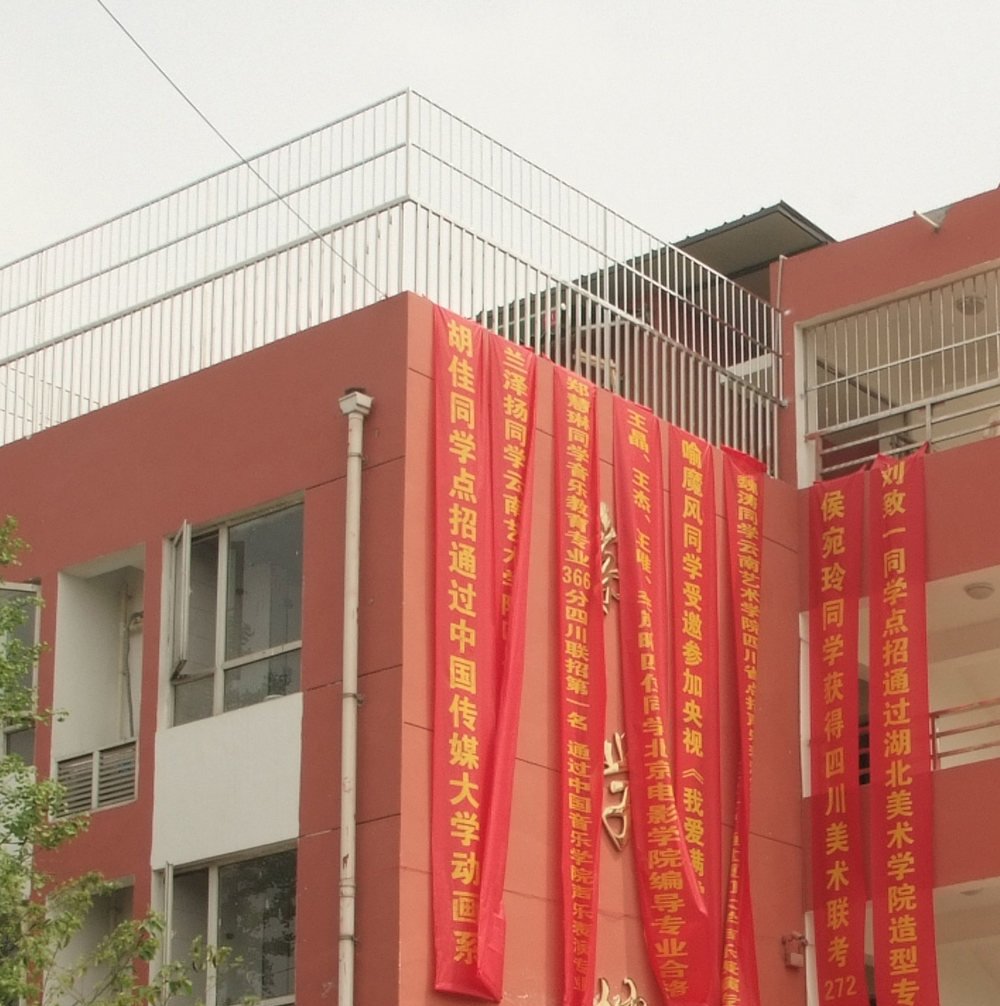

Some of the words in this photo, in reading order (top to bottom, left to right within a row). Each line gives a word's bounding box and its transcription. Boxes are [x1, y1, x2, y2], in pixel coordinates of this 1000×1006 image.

[447, 319, 481, 965] 胡佳同学点招通过中国传媒大学动画系
